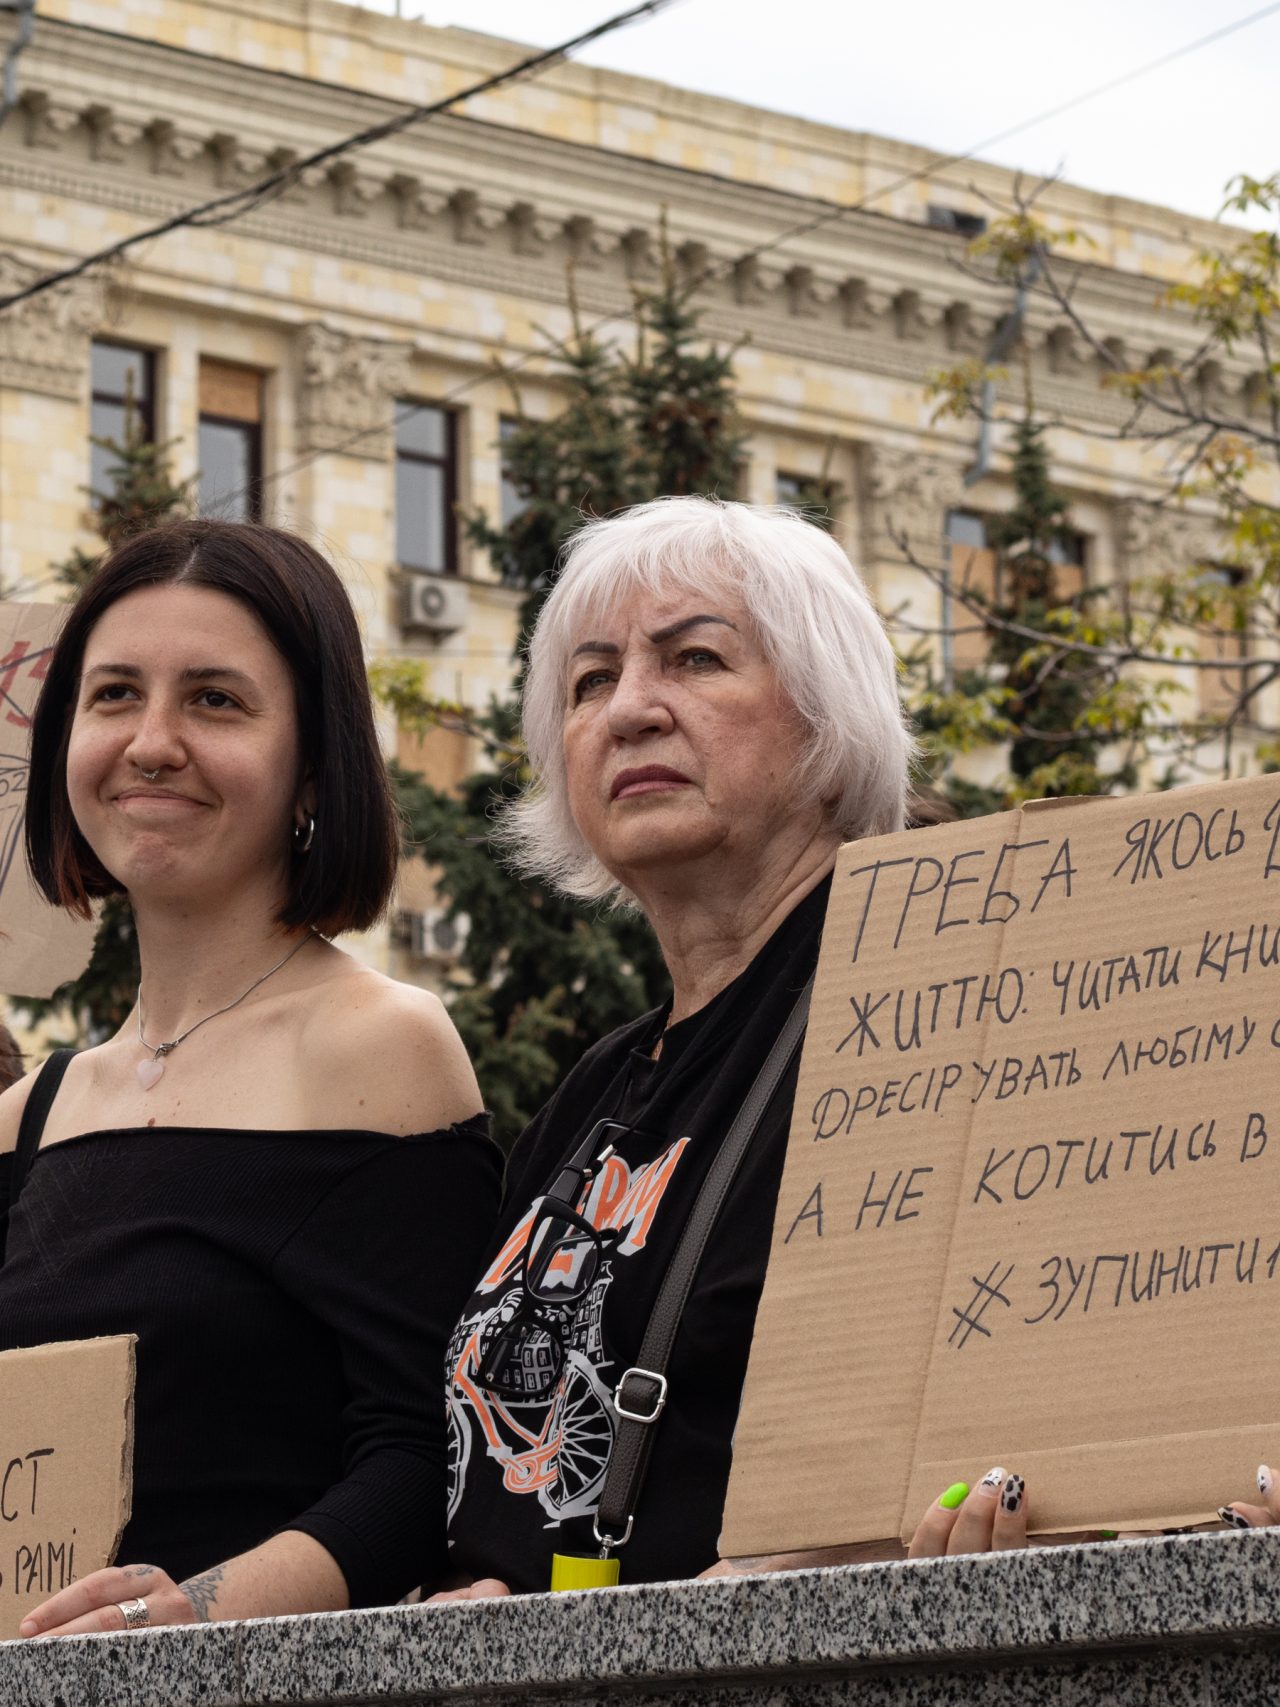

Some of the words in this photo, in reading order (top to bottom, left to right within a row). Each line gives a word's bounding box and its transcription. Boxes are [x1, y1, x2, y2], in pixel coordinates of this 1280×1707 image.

[850, 838, 1078, 963] ТРЕБА
[1114, 808, 1245, 884] ЯКОСЬ
[835, 967, 1035, 1057] ЖИТТЮ:
[1053, 946, 1183, 1016] ЧИТАТИ
[1103, 1016, 1255, 1081] ЛЮБІМУ
[784, 1182, 823, 1244] А
[855, 1167, 934, 1230] НЕ
[974, 1120, 1217, 1204] КОТИТИСЬ
[1240, 1113, 1268, 1163] В
